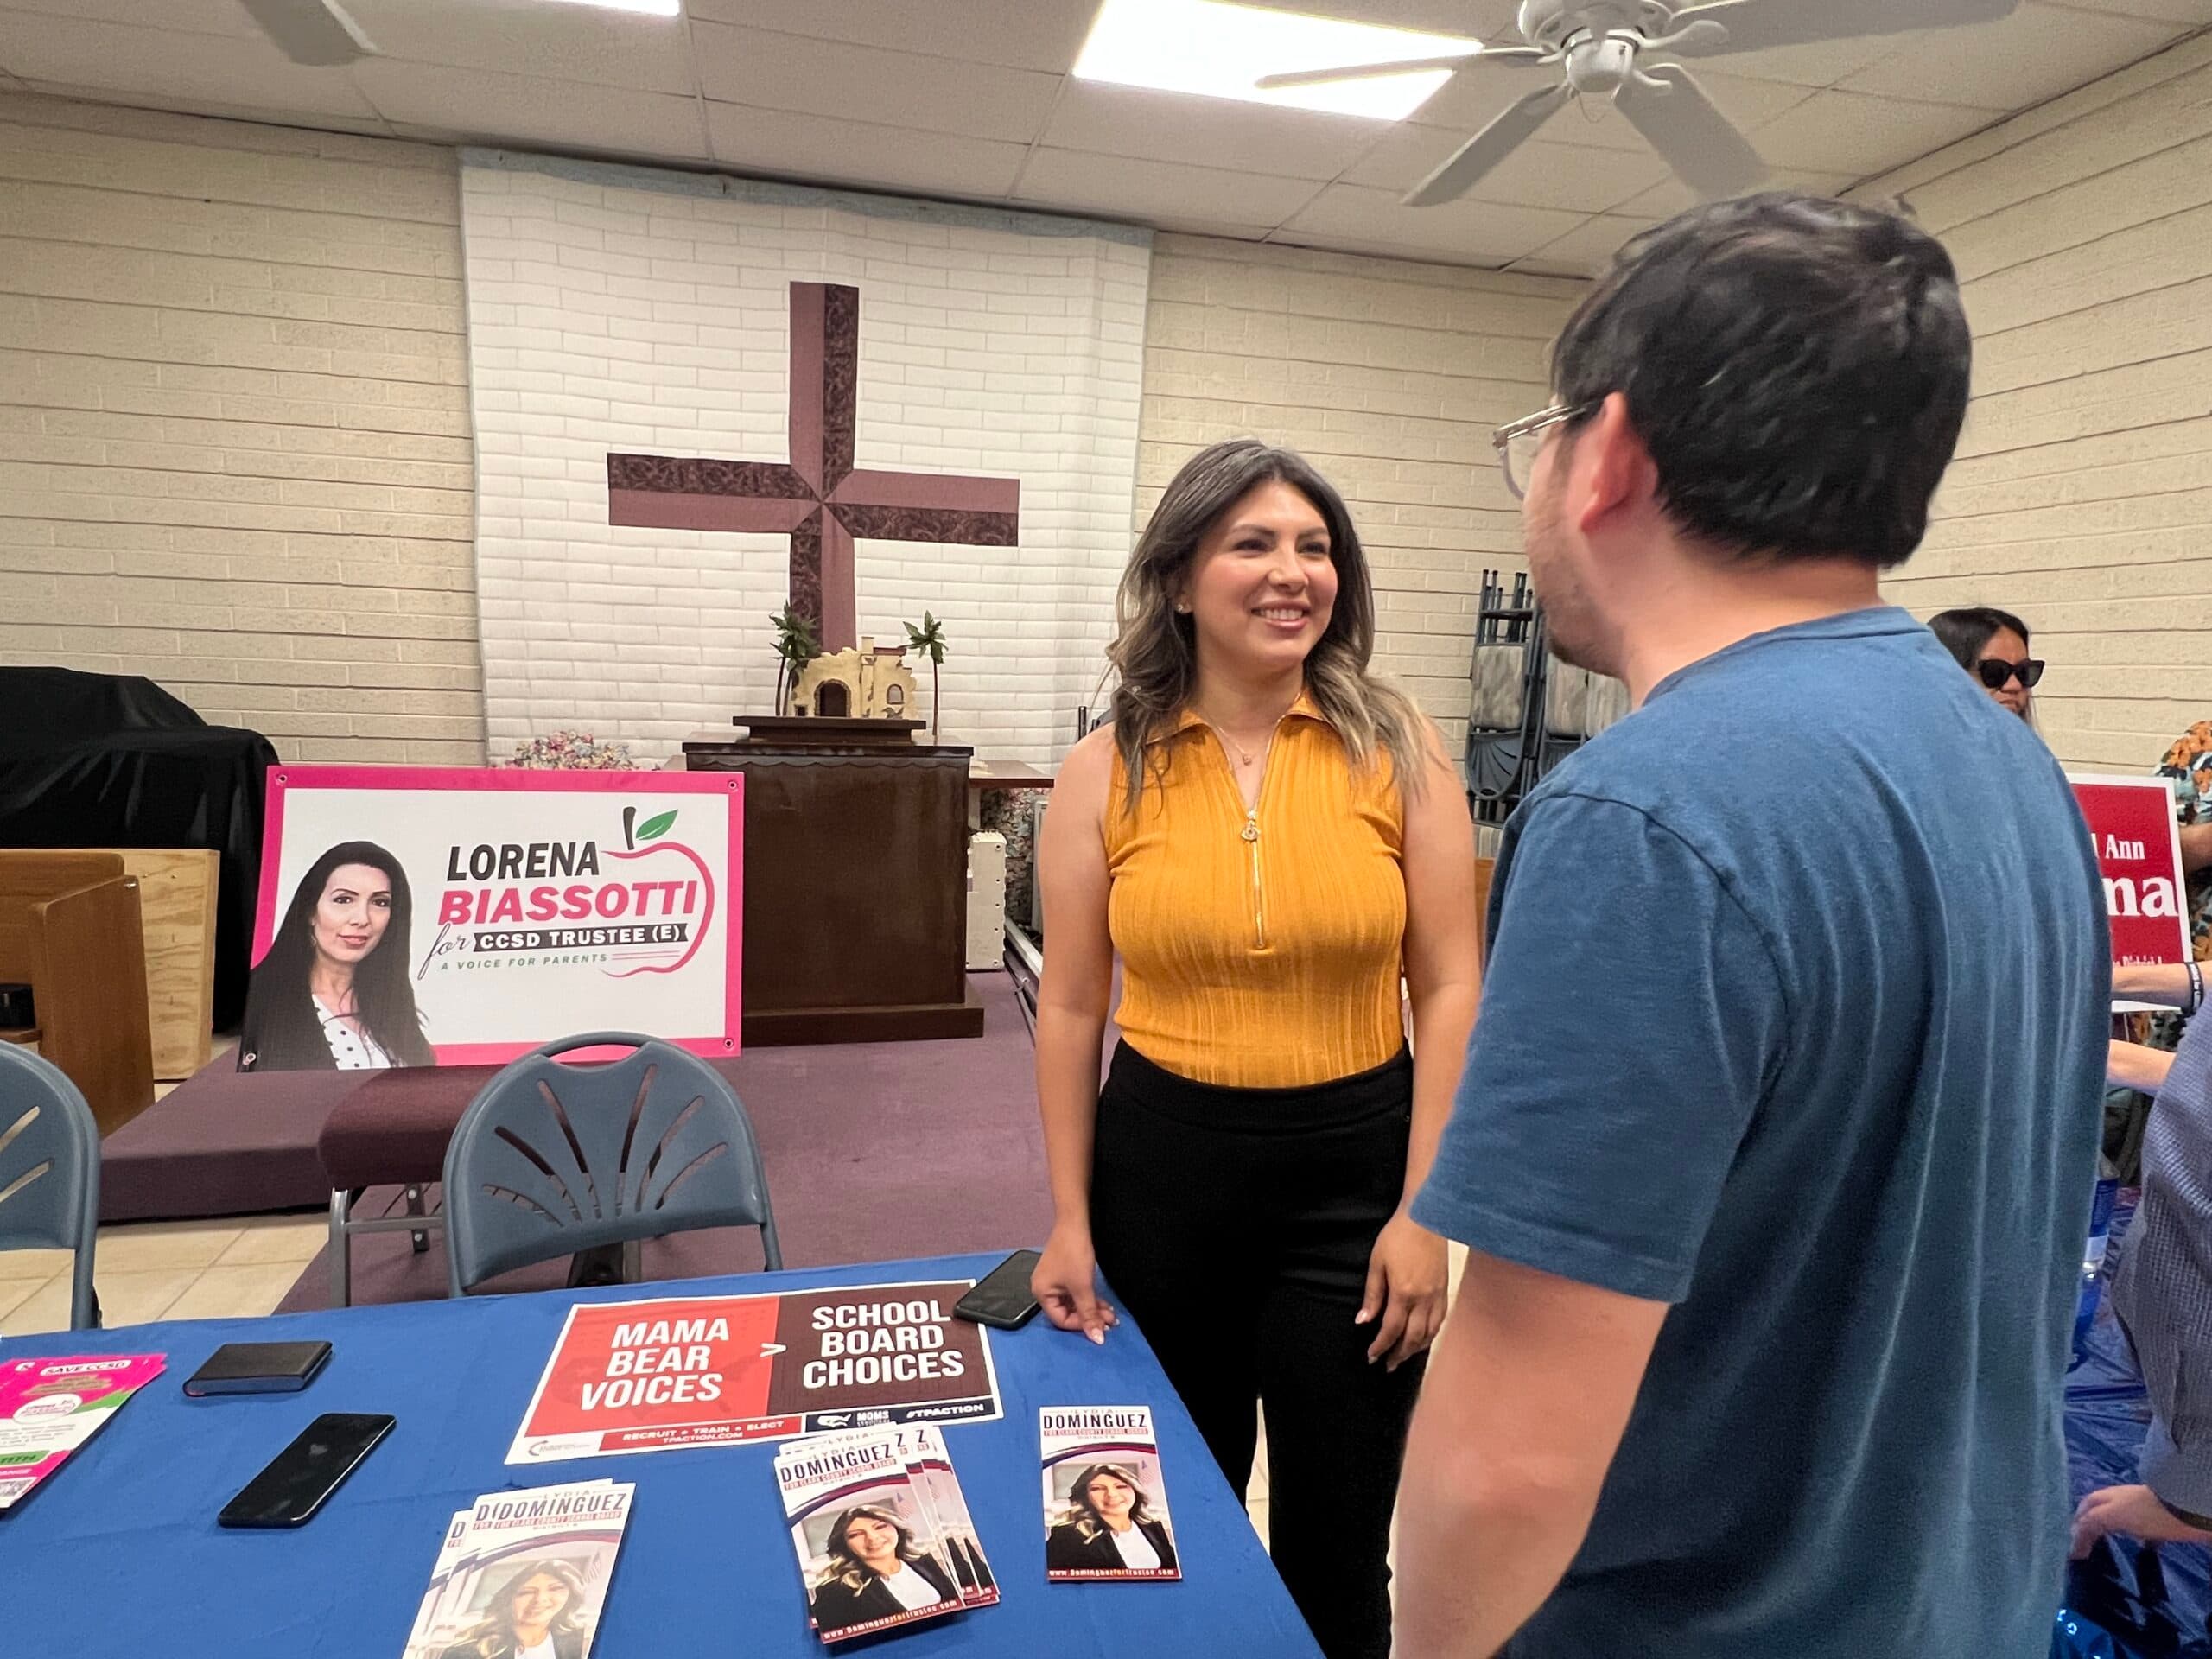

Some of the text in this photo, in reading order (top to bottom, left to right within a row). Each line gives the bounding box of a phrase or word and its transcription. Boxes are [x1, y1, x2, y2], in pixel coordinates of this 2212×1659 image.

[447, 841, 600, 882] LORENA
[2105, 834, 2145, 860] Ann
[438, 880, 697, 925] BIASSOTTI
[2102, 876, 2180, 918] na
[417, 923, 681, 981] for CCSD TRUSTEE (E)
[441, 953, 607, 970] A VOICE FOR PARENTS
[810, 1300, 951, 1331] SCHOOL
[611, 1317, 730, 1349] MAMA
[820, 1325, 944, 1357] BOARD
[605, 1345, 712, 1377] BEAR
[803, 1351, 965, 1389] CHOICES
[580, 1373, 724, 1411] VOICES
[856, 1410, 889, 1421] MOMS
[906, 1403, 985, 1420] #TPACTION
[1043, 1414, 1148, 1429] DOMINGUEZ
[622, 1421, 784, 1441] RECRUIT TRAIN ELECT
[663, 1432, 743, 1444] TPACTION.COM
[780, 1444, 893, 1483] DOMINGUEZ
[498, 1493, 627, 1521] DOMINGUEZ
